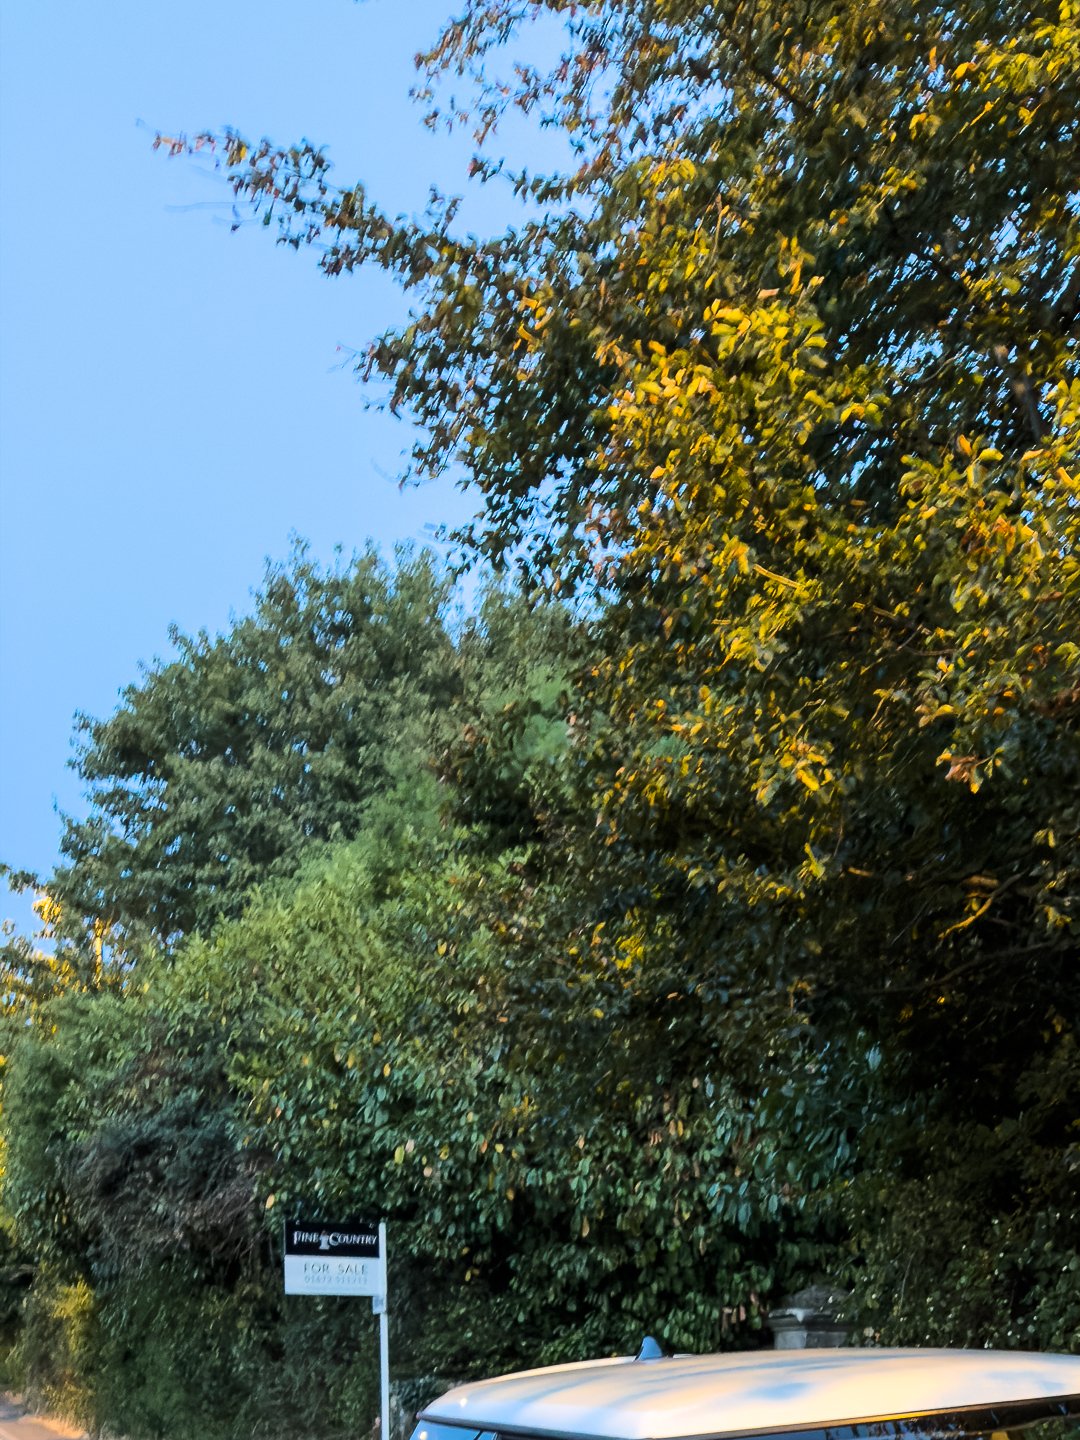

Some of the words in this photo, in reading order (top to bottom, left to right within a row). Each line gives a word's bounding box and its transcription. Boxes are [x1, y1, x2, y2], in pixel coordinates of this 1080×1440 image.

[328, 1232, 378, 1246] COUNTRY
[303, 1263, 329, 1274] FOR
[338, 1263, 369, 1275] SALE
